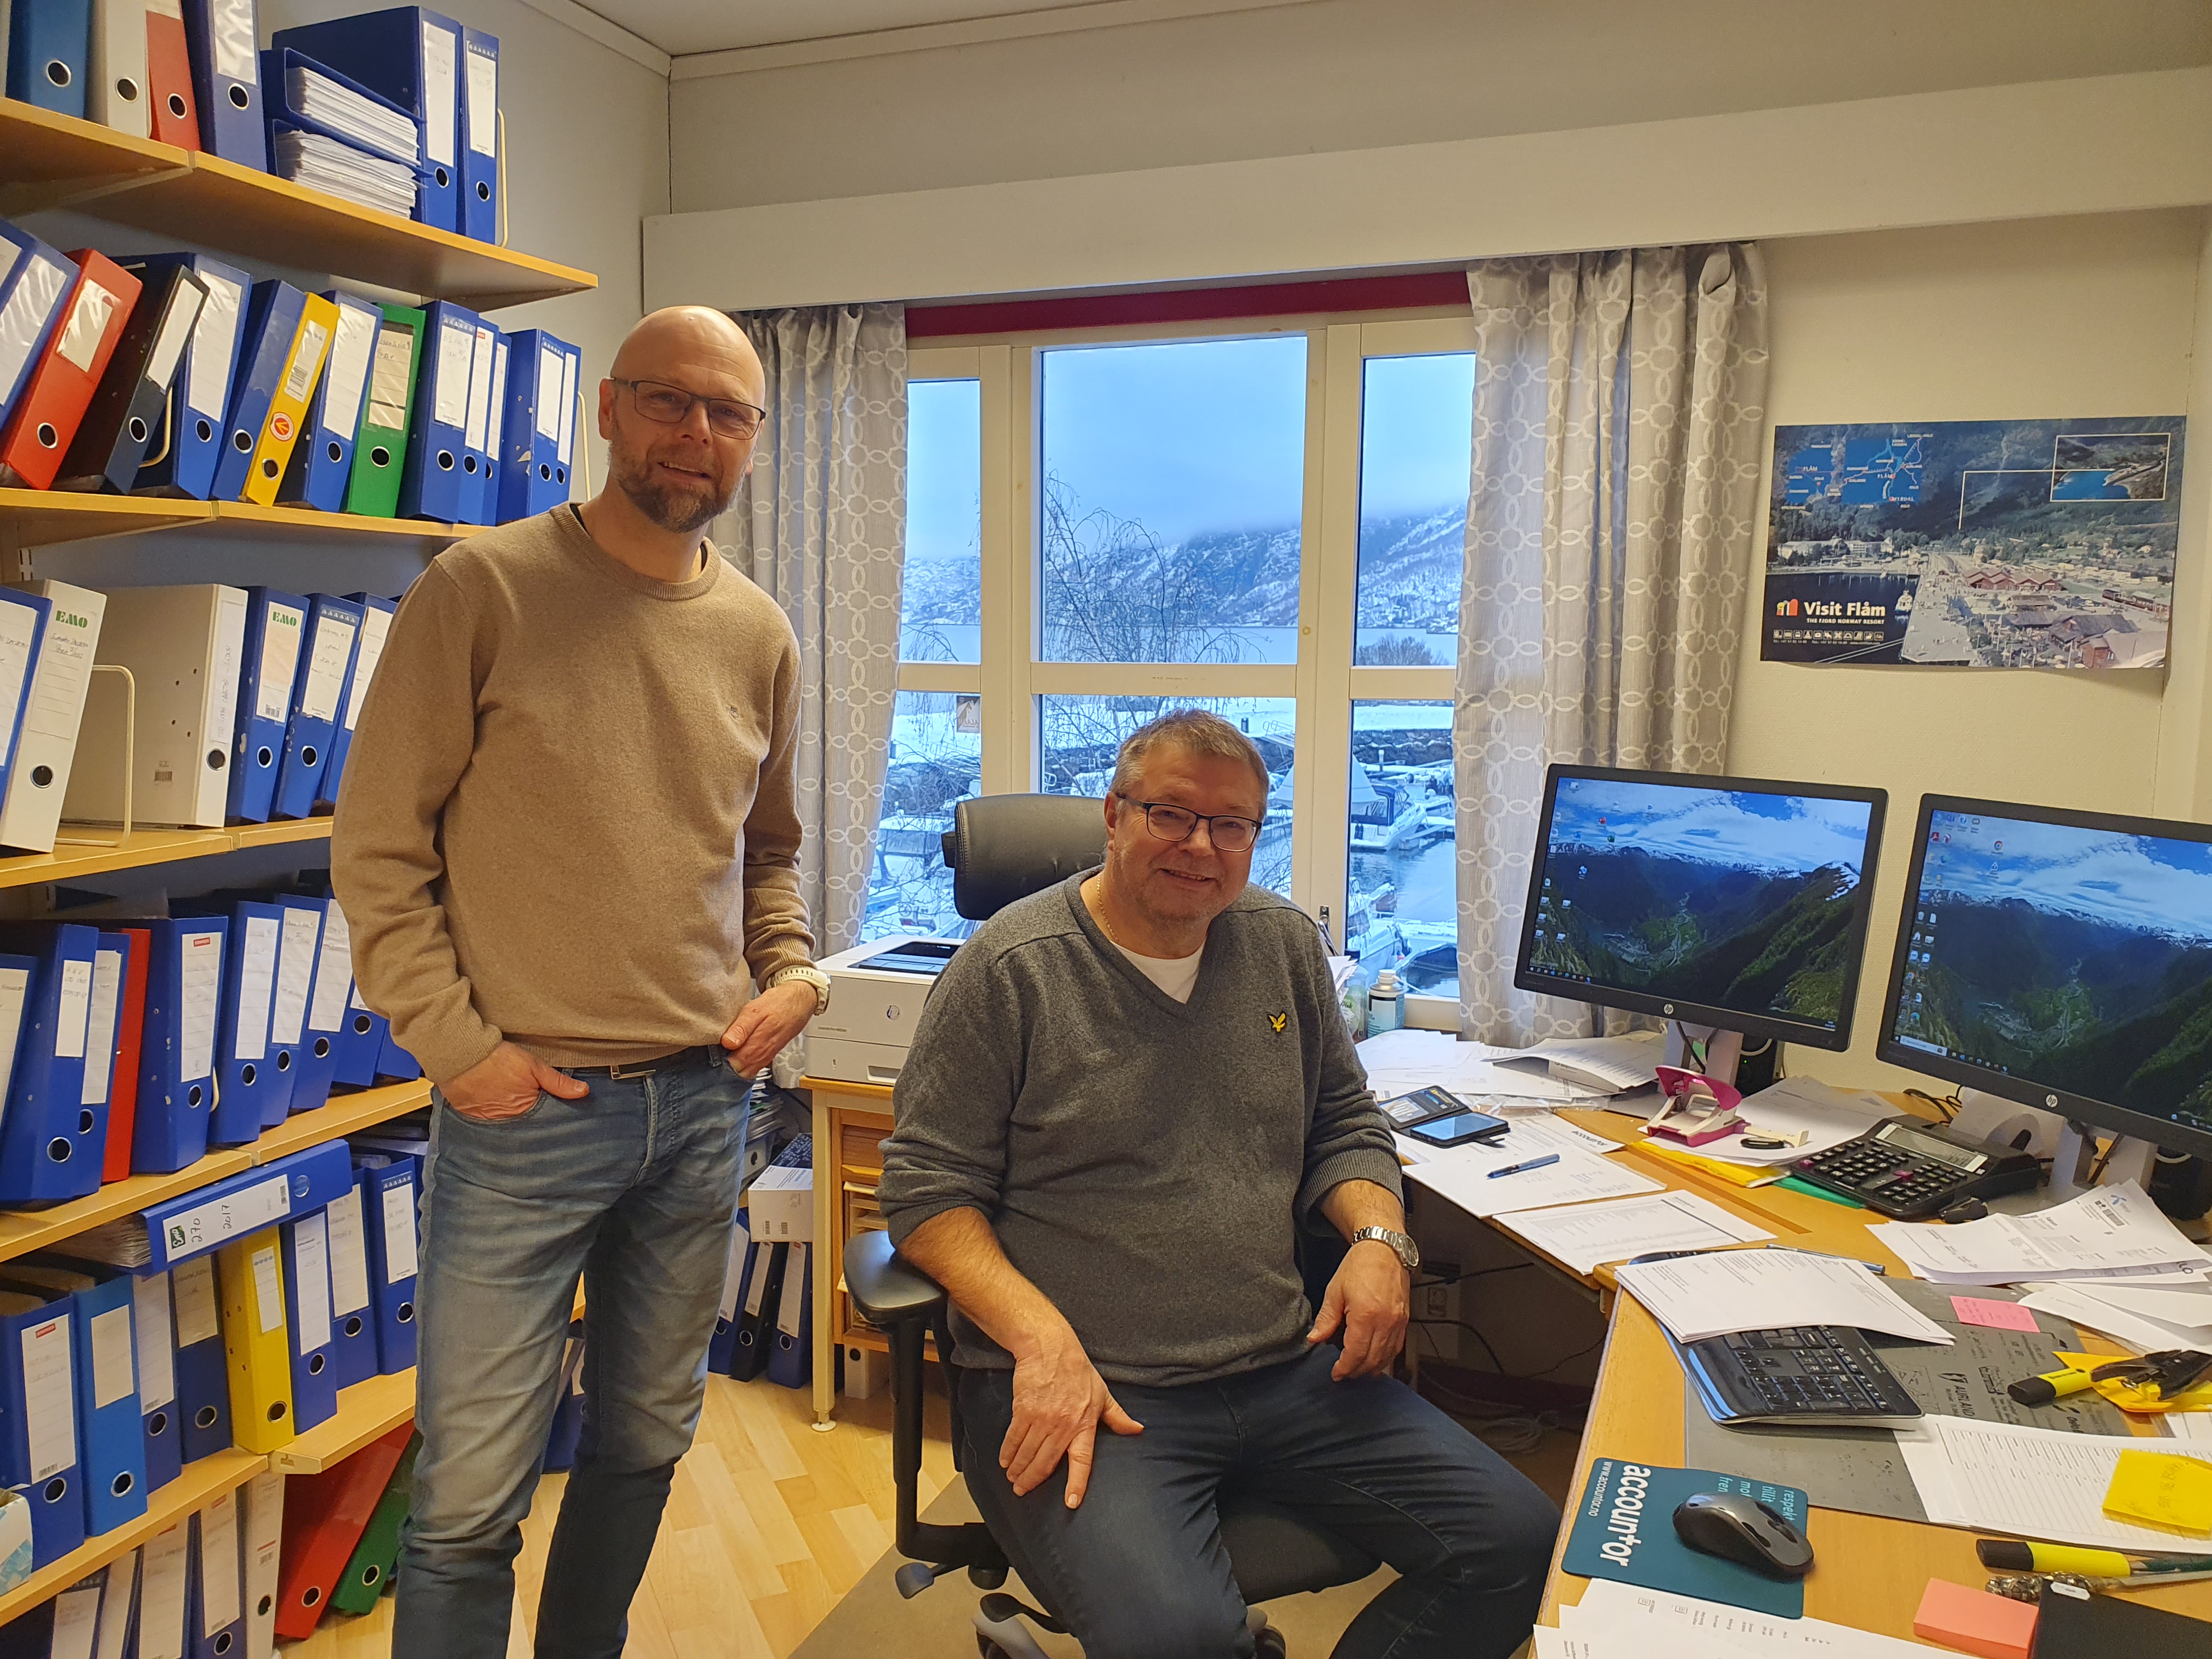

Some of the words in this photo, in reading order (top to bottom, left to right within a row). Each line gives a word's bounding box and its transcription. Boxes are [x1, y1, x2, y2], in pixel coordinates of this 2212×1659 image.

[55, 610, 88, 628] EMO
[272, 611, 297, 627] EMO
[1804, 601, 1842, 616] Visit
[1847, 601, 1886, 617] Flåm
[2046, 1094, 2058, 1107] hp
[221, 1204, 233, 1229] 2017
[190, 1217, 203, 1243] 270
[1954, 1385, 1976, 1417] AURLAND
[1588, 1462, 1613, 1516] www.accountor.no
[1761, 1486, 1776, 1503] tillit
[1600, 1465, 1651, 1567] accountor
[1780, 1489, 1797, 1521] respekt
